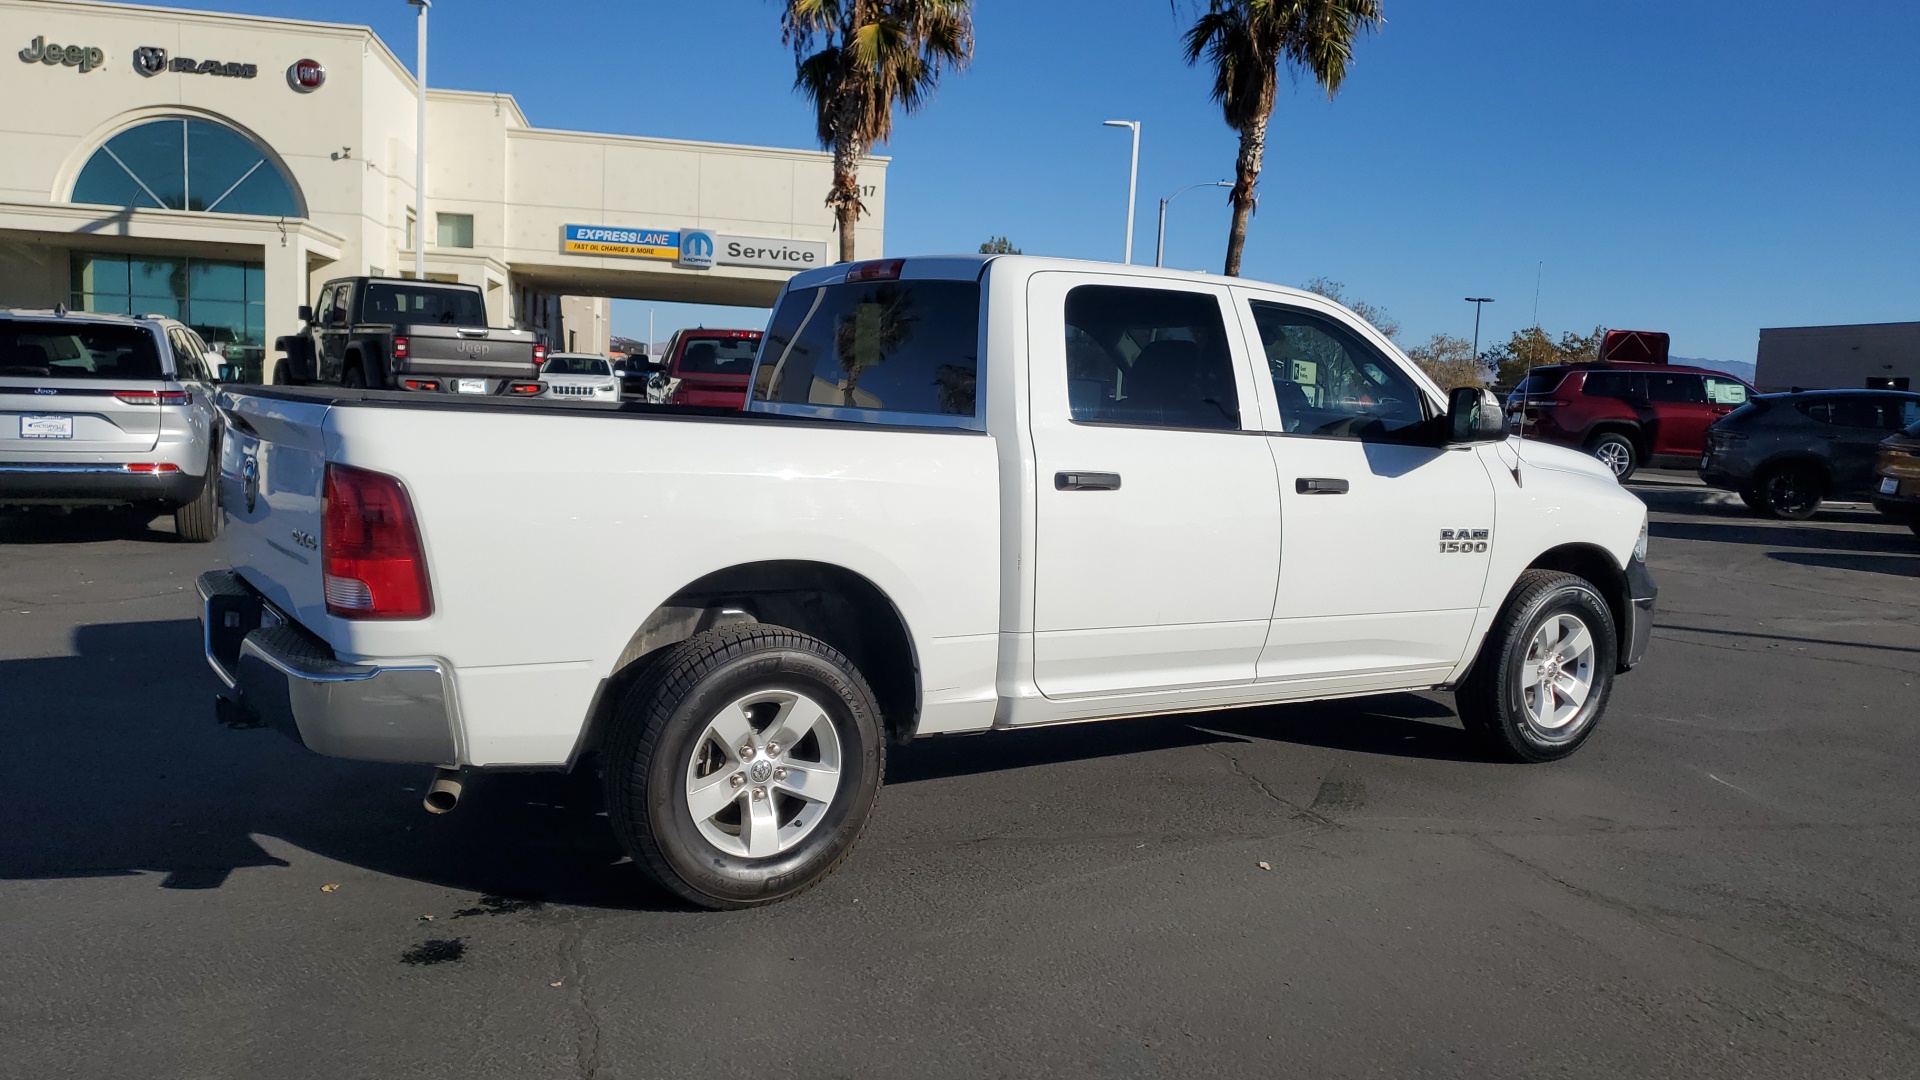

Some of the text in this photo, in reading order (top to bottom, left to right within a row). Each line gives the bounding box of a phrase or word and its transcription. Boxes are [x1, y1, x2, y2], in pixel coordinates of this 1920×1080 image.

[20, 36, 104, 72] Jeep
[171, 57, 257, 79] RAM
[300, 66, 321, 81] FIAT
[577, 229, 669, 245] EXPRESSLANE
[637, 247, 655, 255] MORE
[727, 242, 815, 263] Service
[456, 341, 490, 356] Jeep
[34, 388, 57, 396] Jeep
[1440, 528, 1489, 540] RAM
[1439, 541, 1488, 553] 1500
